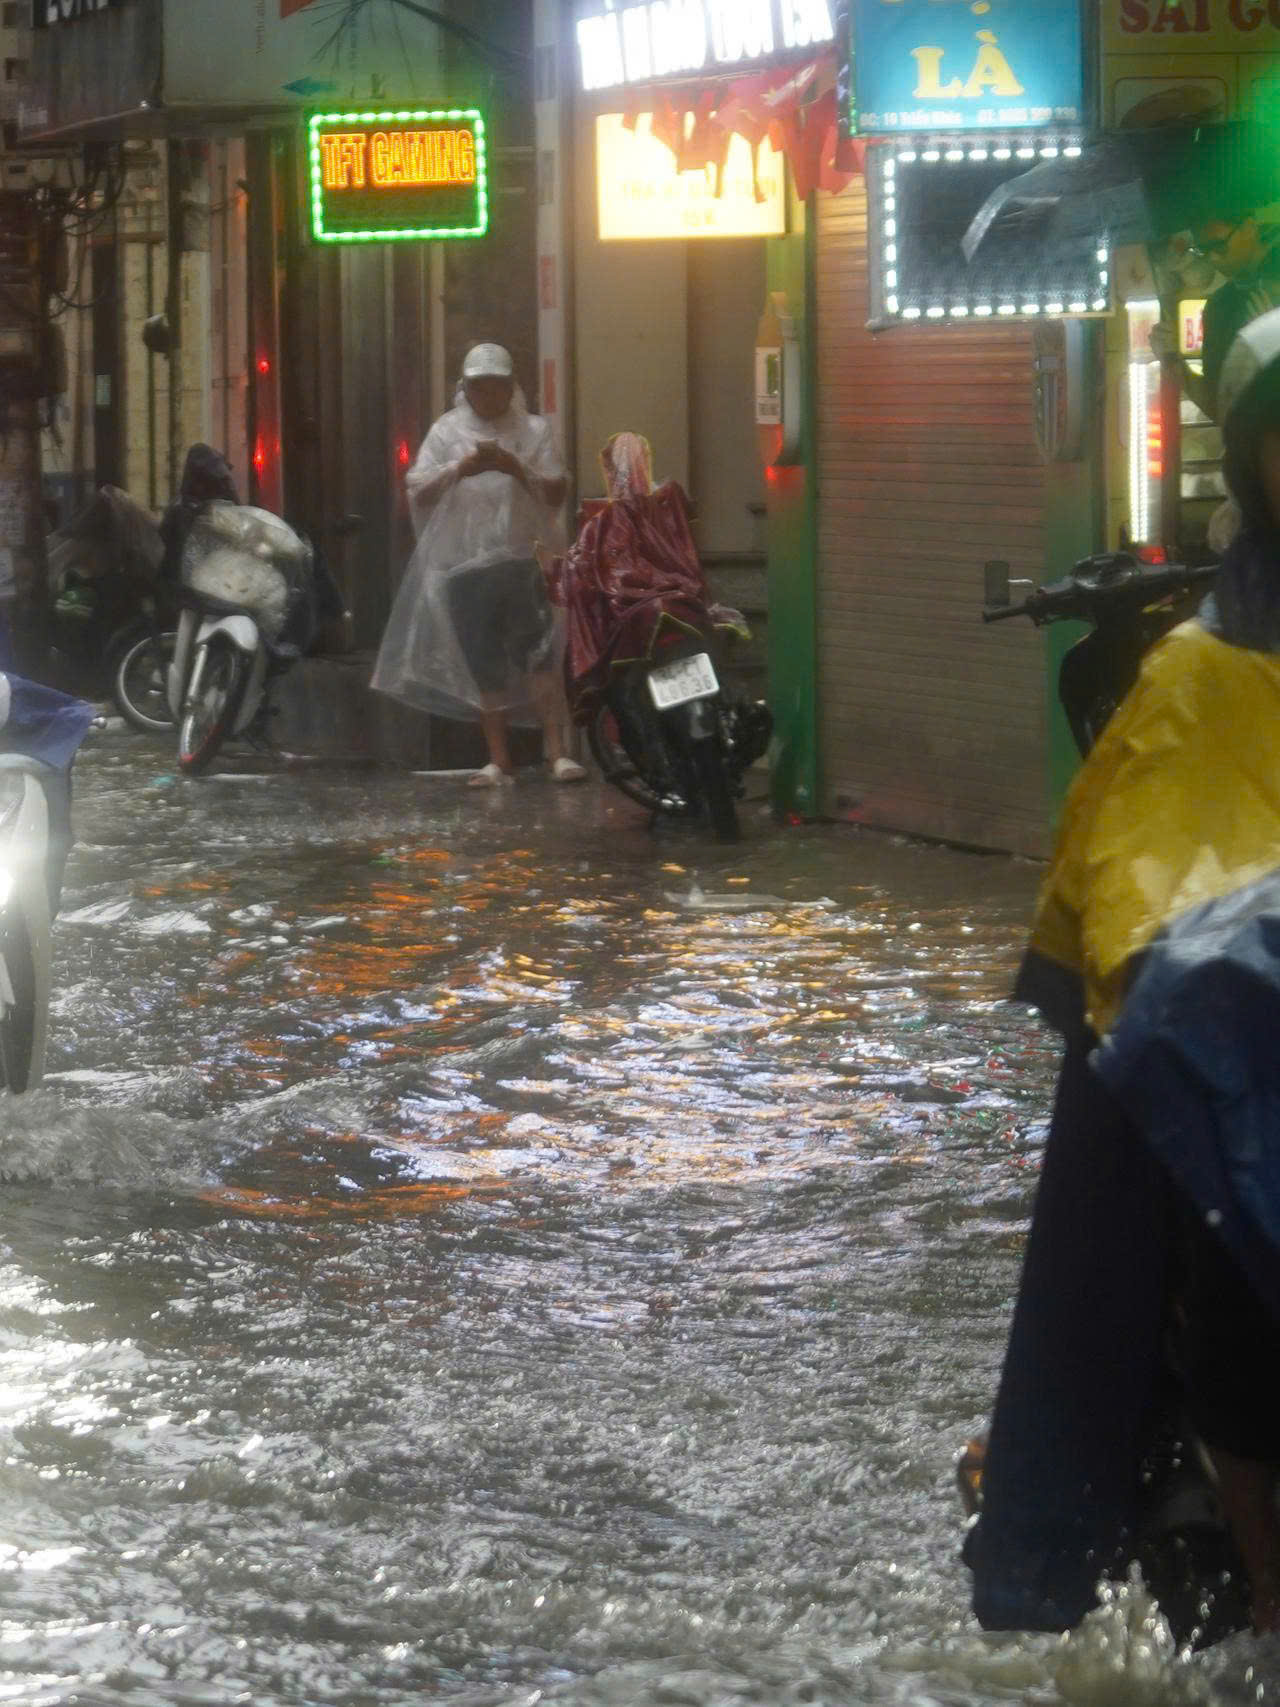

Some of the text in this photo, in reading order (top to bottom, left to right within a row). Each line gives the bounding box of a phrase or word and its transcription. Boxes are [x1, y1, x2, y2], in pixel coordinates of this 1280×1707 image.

[1120, 0, 1211, 33] SAI
[910, 29, 1025, 98] LÀ
[320, 129, 476, 188] TFT GAMING
